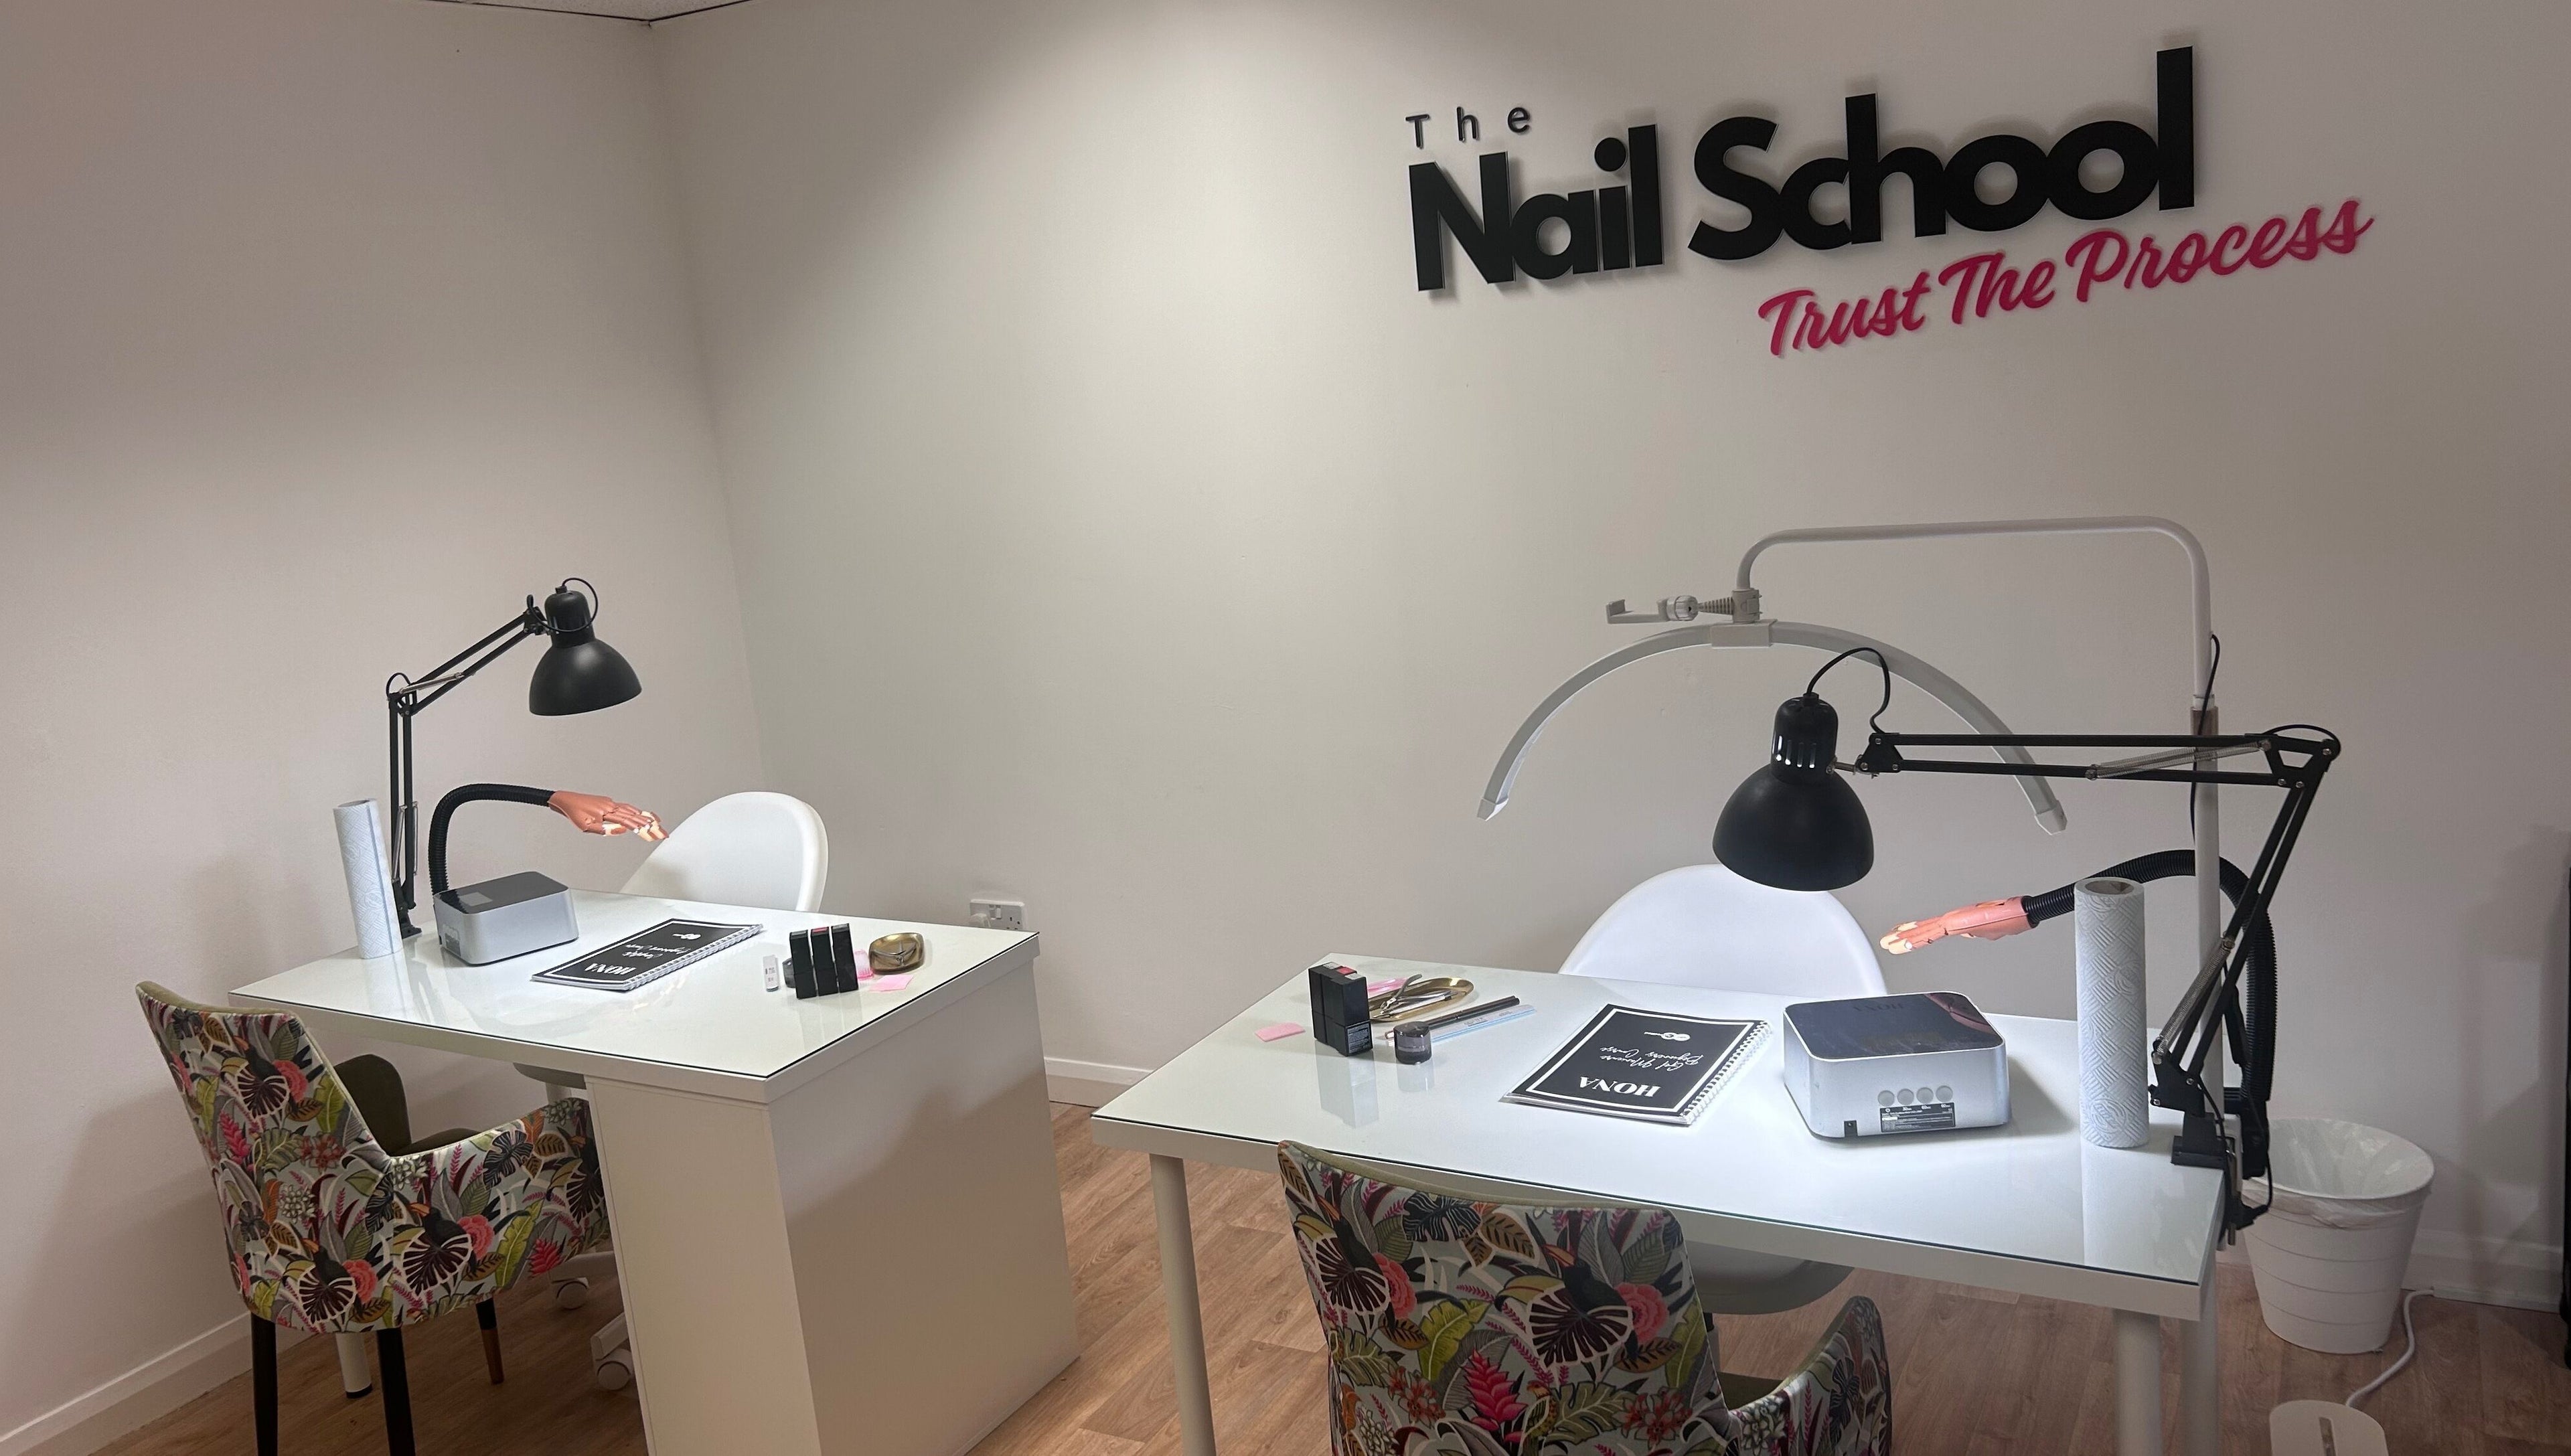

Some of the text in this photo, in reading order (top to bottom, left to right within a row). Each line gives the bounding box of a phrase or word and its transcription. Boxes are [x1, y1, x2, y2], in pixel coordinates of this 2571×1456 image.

[1406, 106, 1530, 148] The
[1409, 45, 2195, 291] Nail School
[1758, 199, 2375, 357] Trust The Process
[1579, 1076, 1661, 1097] HONA
[1654, 1060, 1685, 1072] Gel
